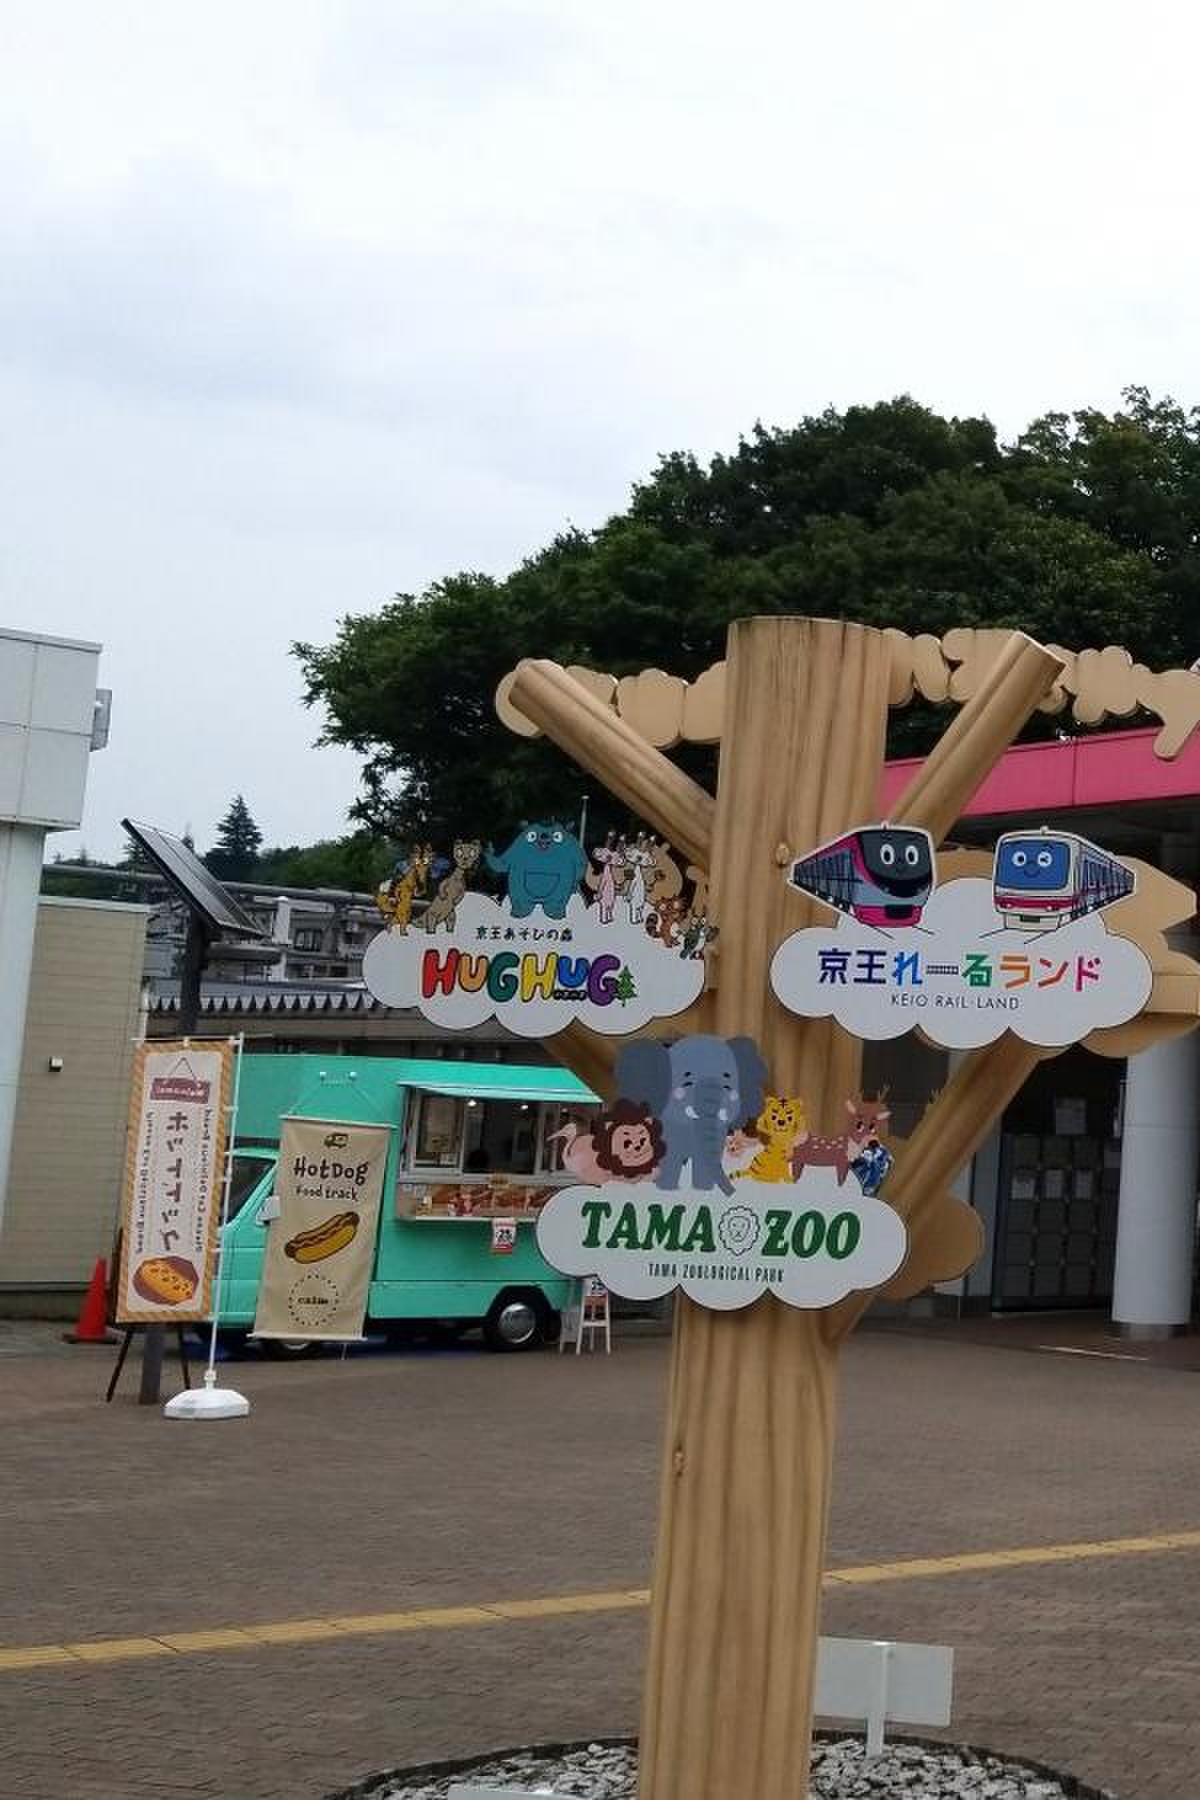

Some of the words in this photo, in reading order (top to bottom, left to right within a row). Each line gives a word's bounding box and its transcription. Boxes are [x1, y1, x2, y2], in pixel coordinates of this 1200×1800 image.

[475, 926, 573, 942] 京王あそびの森
[818, 948, 1101, 992] 京王れーるランド
[891, 993, 929, 1008] KEIO
[580, 1201, 716, 1252] TAMA
[761, 1210, 861, 1259] ZOO
[649, 1263, 677, 1278] TAMA
[682, 1264, 750, 1281] ZOOLOGICAL
[755, 1267, 785, 1283] PARK
